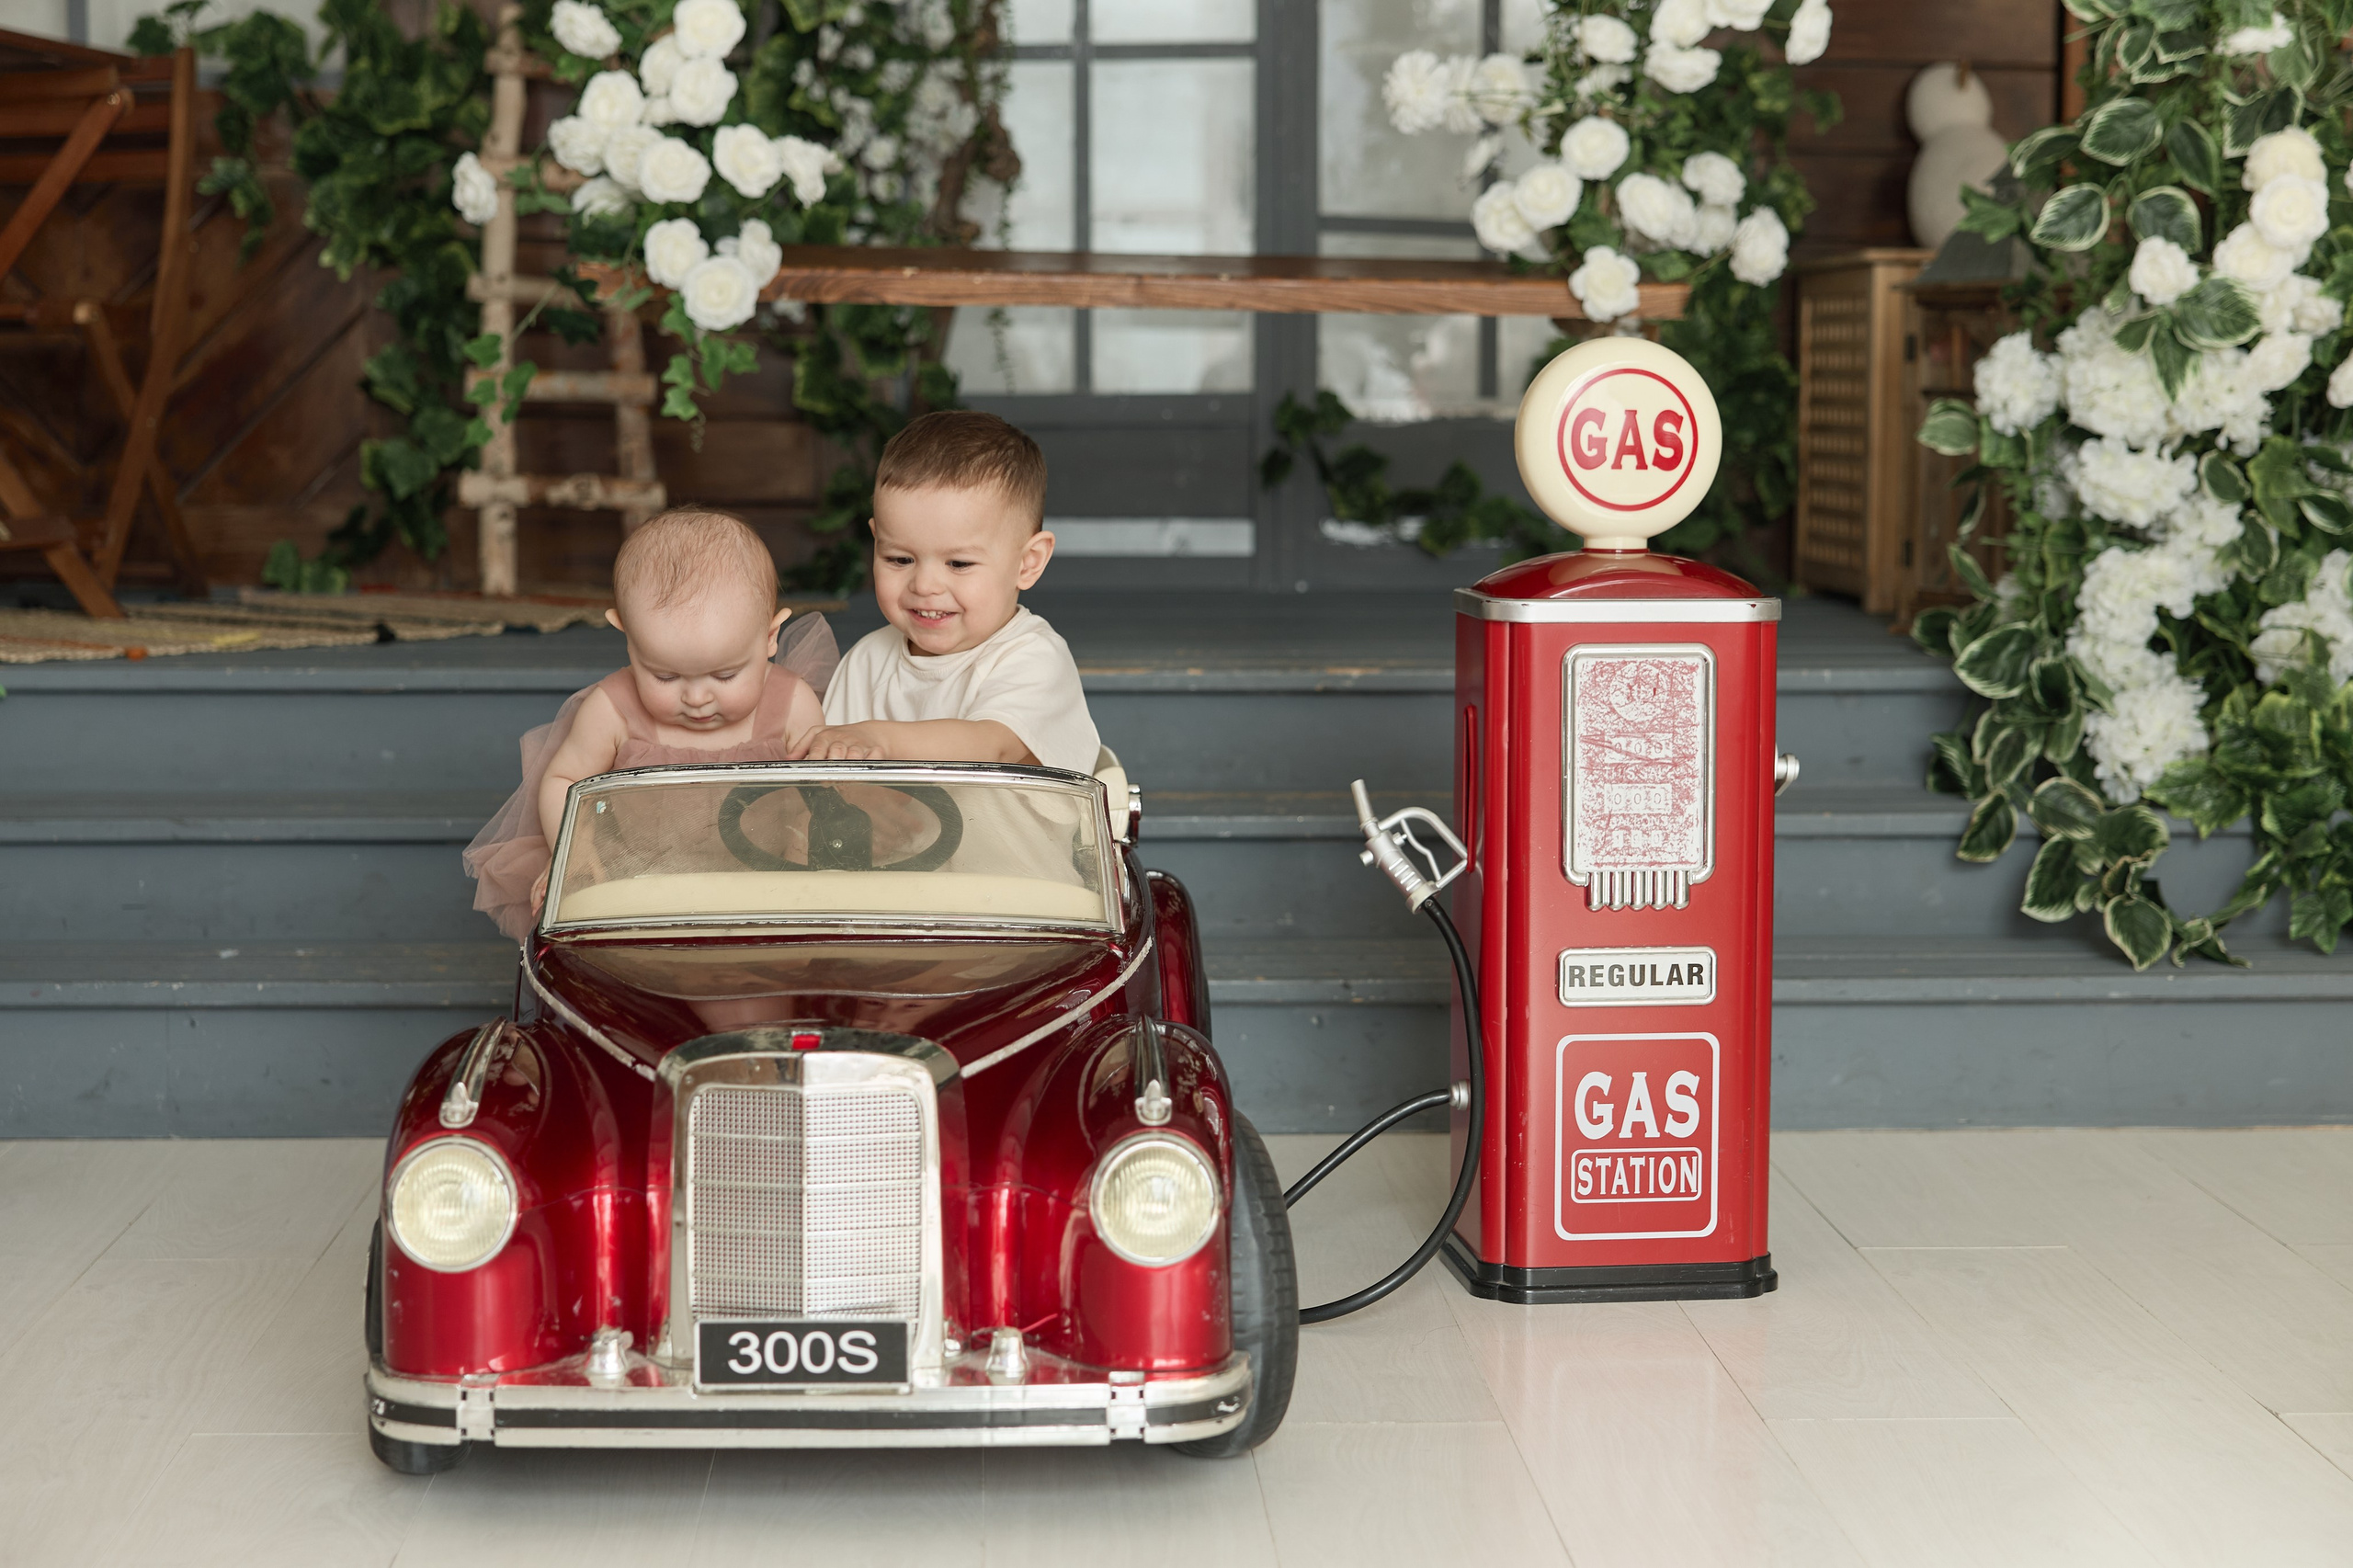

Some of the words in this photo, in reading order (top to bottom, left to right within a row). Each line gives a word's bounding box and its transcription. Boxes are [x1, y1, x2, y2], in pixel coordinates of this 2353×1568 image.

[1570, 407, 1684, 472] GAS
[1568, 963, 1705, 988] REGULAR
[1574, 1070, 1700, 1140] GAS
[1576, 1155, 1698, 1196] STATION
[727, 1330, 879, 1375] 300S
